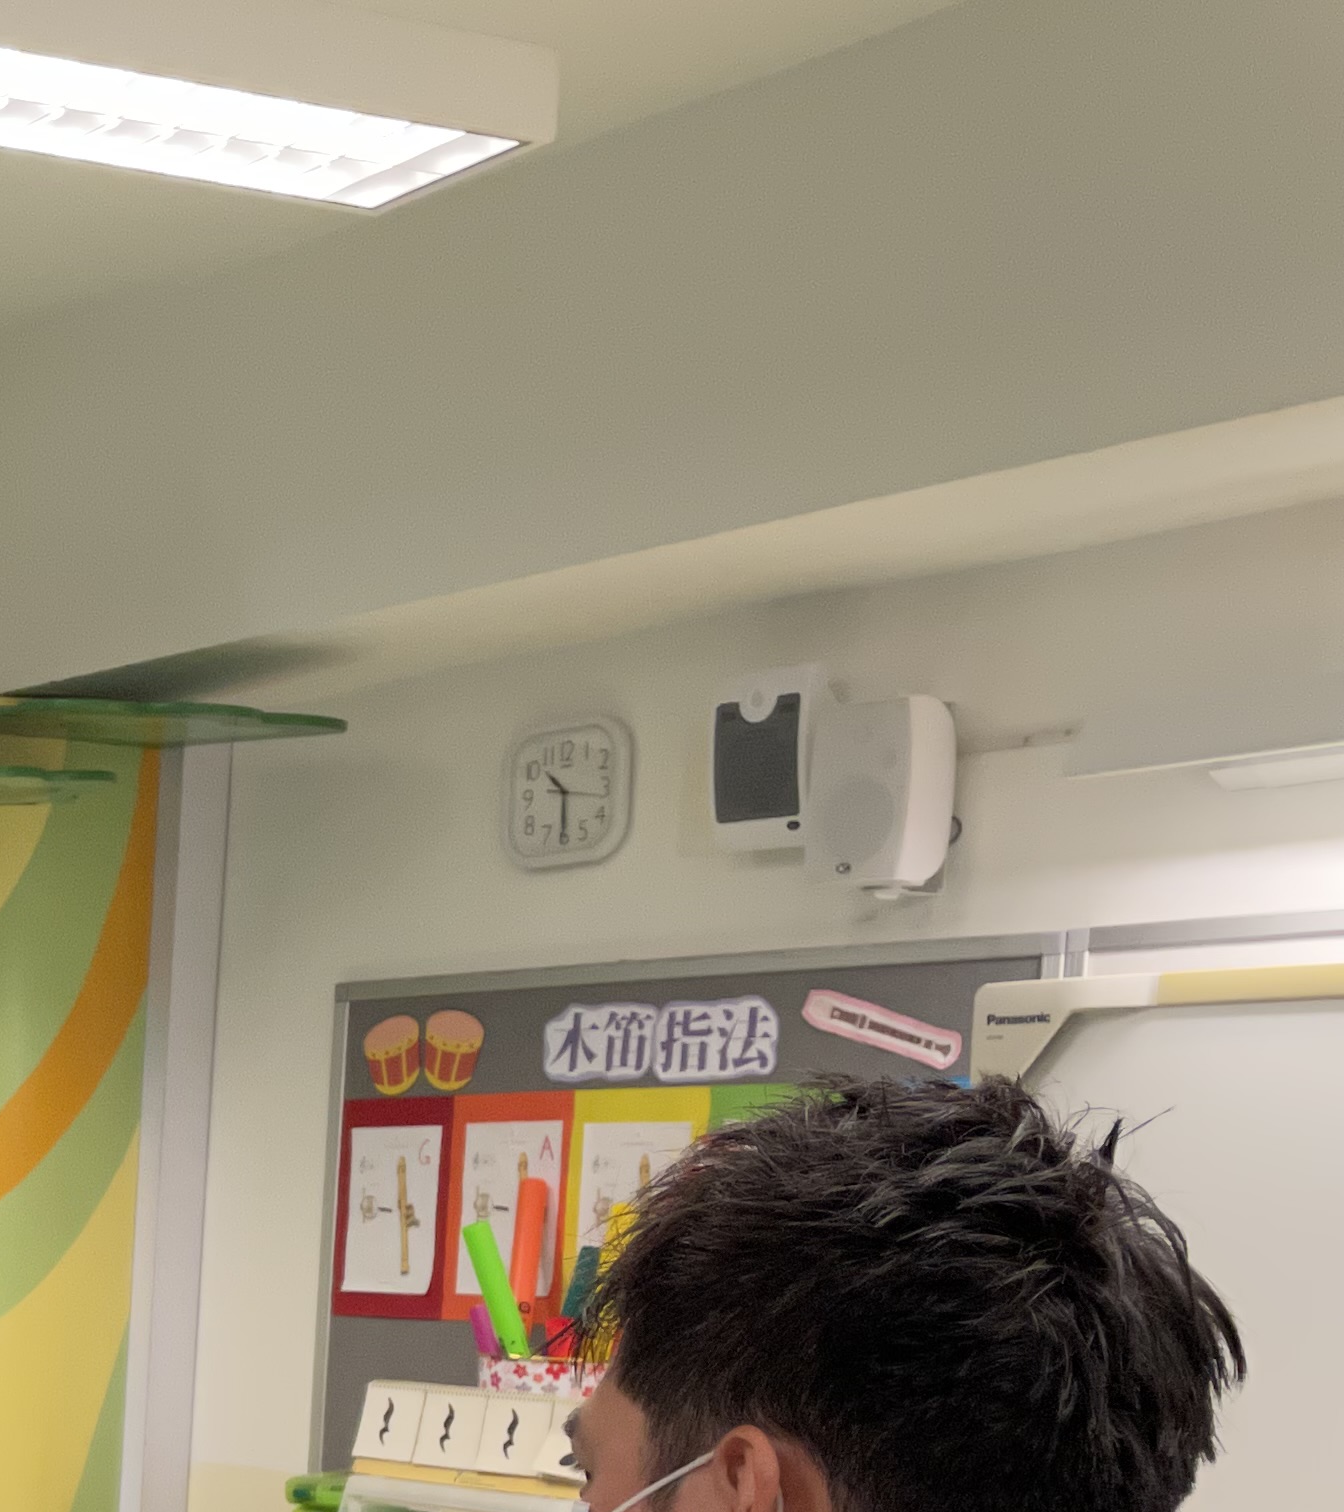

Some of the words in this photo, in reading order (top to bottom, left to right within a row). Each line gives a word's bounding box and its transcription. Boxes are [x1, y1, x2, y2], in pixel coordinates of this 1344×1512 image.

[543, 746, 555, 766] 11
[559, 740, 575, 762] 12
[598, 748, 610, 770] 2
[526, 760, 541, 782] 10
[600, 776, 611, 799] 3
[522, 789, 534, 811] 9
[524, 815, 535, 836] 8
[595, 805, 607, 825] 4
[541, 824, 553, 846] 7
[577, 819, 589, 841] 5
[986, 1010, 1052, 1027] Panasonic
[551, 1007, 771, 1072] 木笛指法
[418, 1138, 432, 1166] G
[539, 1135, 555, 1162] A
